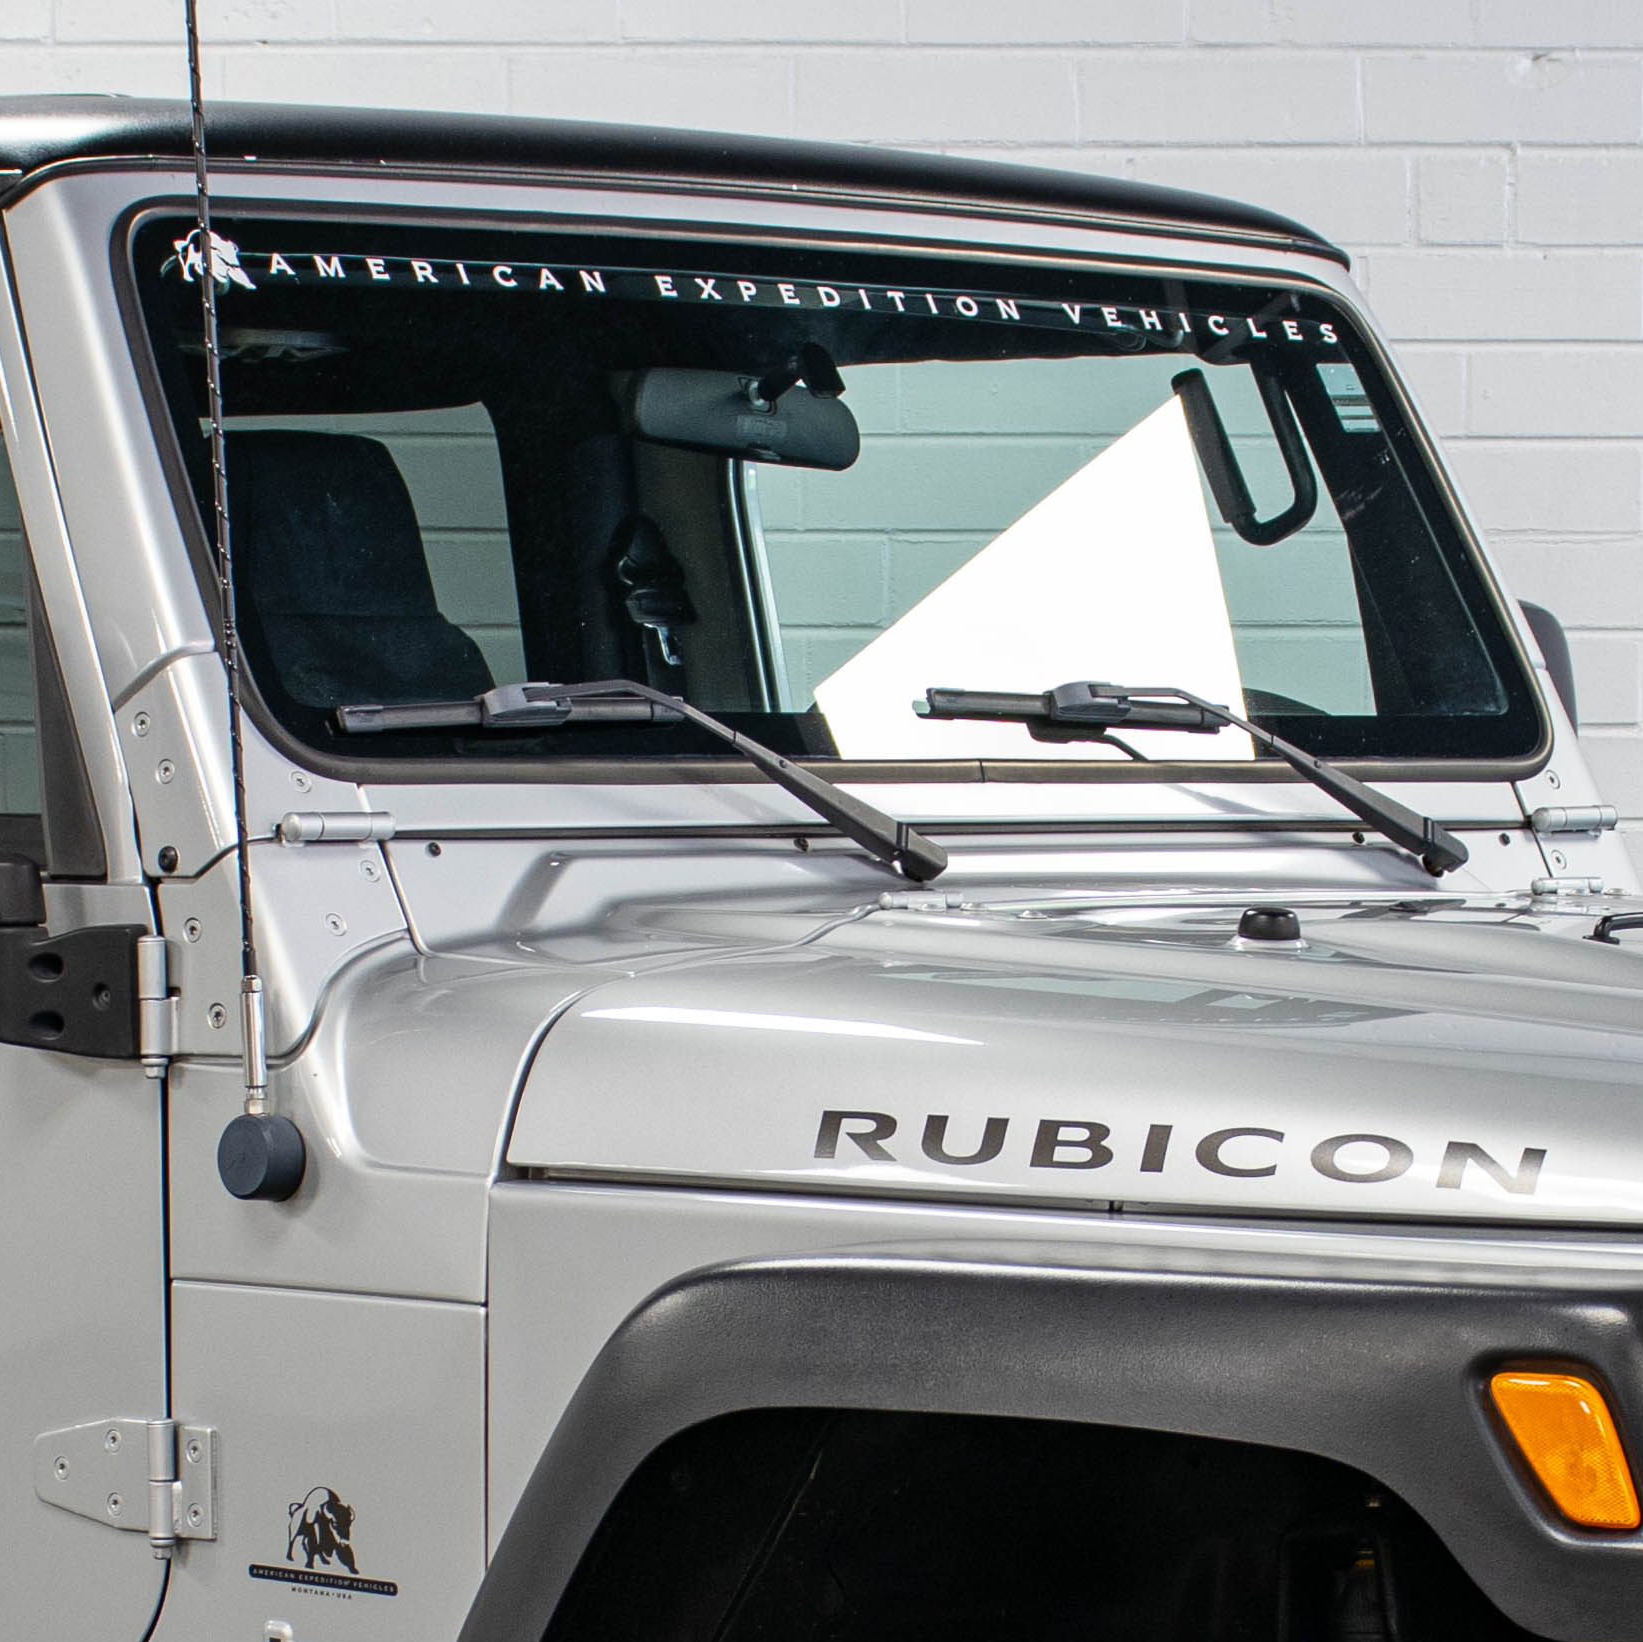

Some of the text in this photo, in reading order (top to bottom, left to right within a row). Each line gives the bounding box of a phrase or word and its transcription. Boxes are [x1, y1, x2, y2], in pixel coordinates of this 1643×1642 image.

[269, 252, 1339, 344] AMERICAN EXPEDITION VEHICLES
[813, 1110, 1547, 1195] RUBICON
